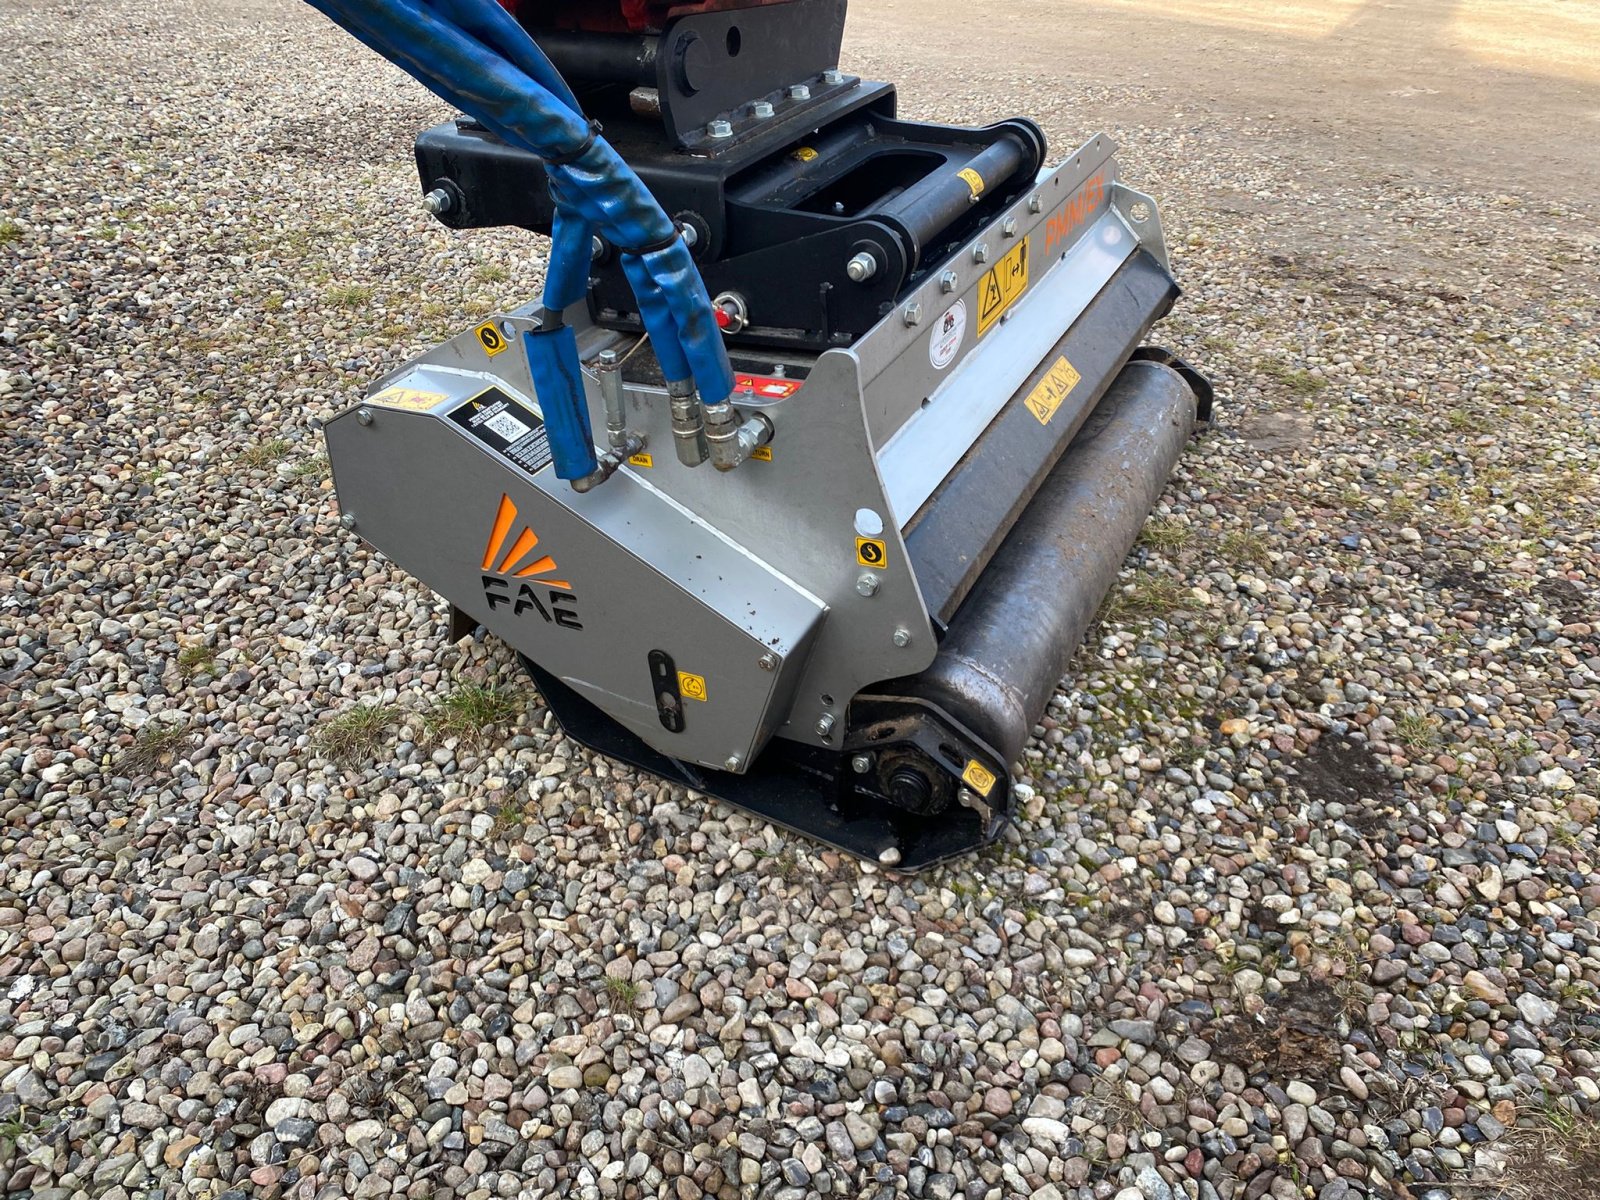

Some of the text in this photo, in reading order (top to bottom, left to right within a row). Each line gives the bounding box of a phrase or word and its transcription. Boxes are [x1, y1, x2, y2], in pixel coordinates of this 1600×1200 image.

[1044, 171, 1105, 257] PMM/EX
[632, 455, 649, 464] DRAIN
[481, 575, 583, 631] FAE
